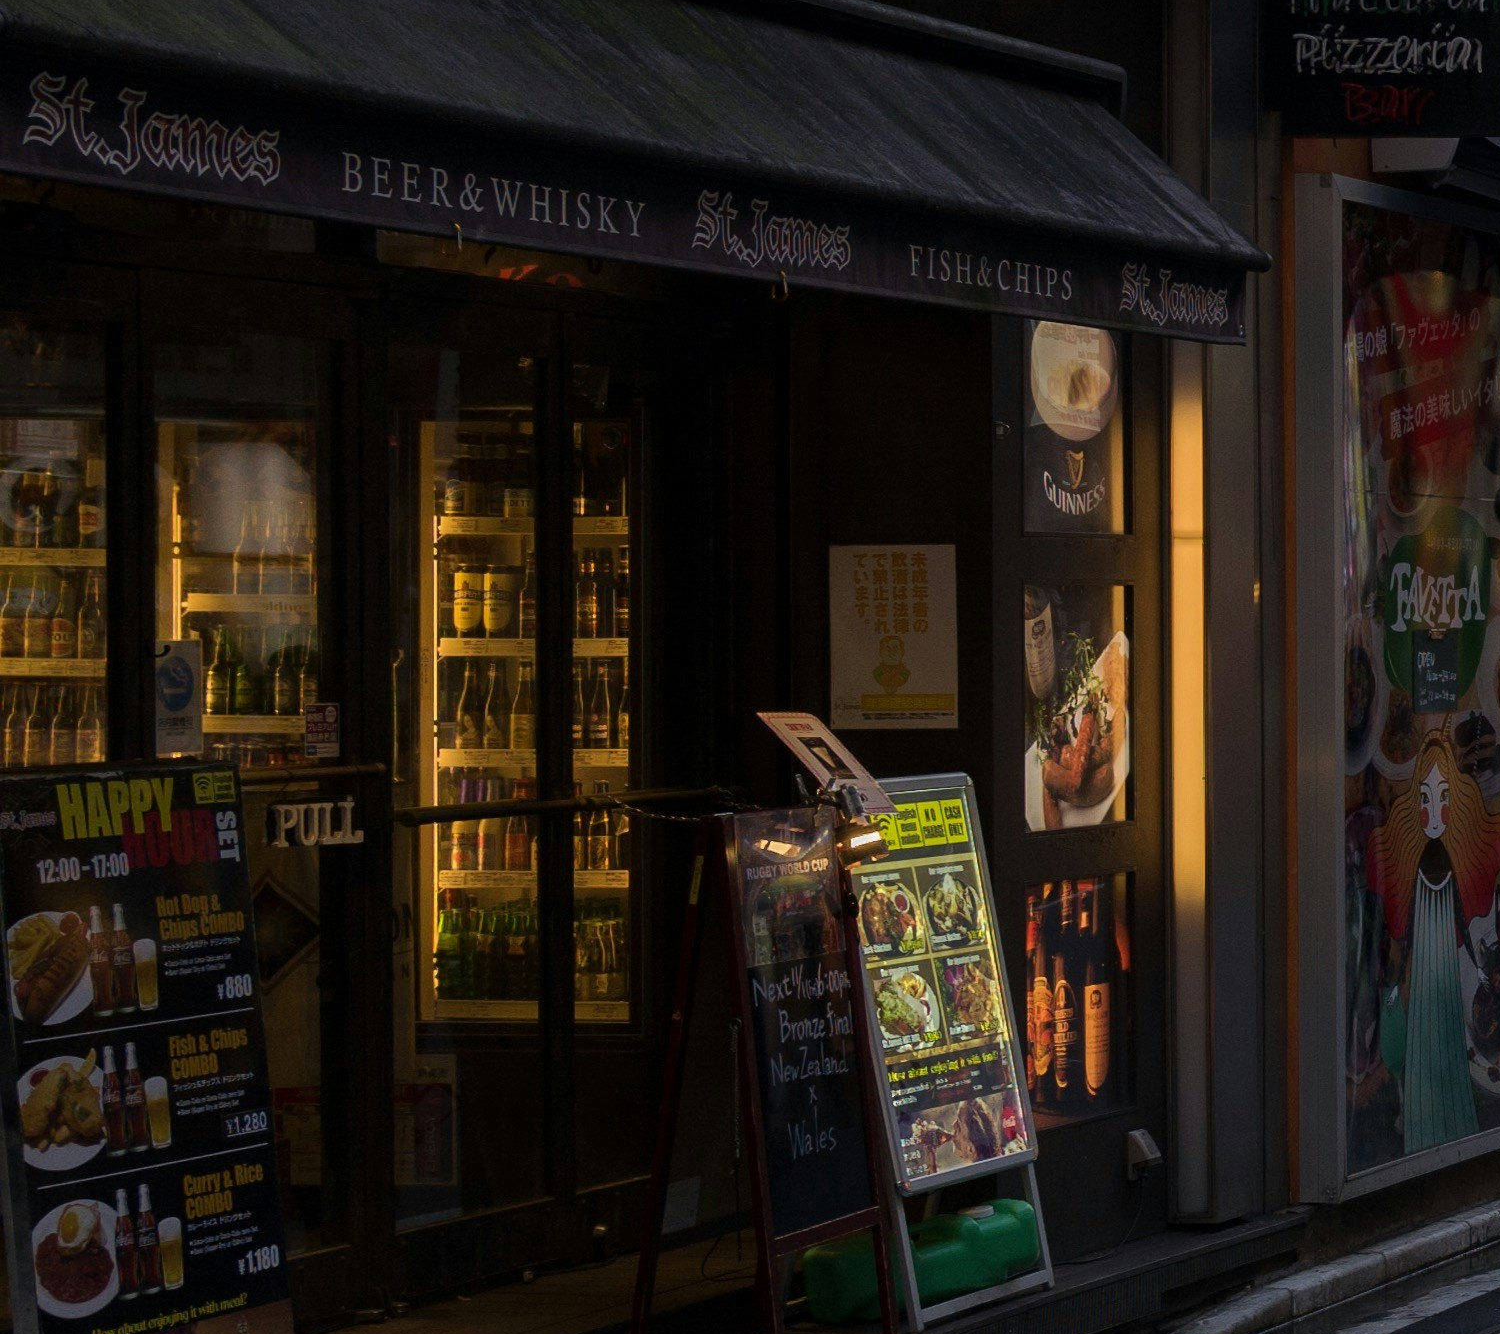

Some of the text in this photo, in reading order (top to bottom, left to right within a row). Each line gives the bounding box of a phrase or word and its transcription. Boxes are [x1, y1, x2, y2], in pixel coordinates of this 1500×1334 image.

[1044, 470, 1107, 516] GUINNESS
[55, 777, 175, 841] HAPPY
[122, 808, 221, 868] HOUR
[216, 810, 241, 863] SET
[746, 857, 830, 881] RUGBY WORLD CUP
[216, 974, 252, 1001] ¥880
[171, 1051, 219, 1081] COMBO
[787, 1105, 838, 1160] Wales
[185, 1190, 234, 1220] COMBO
